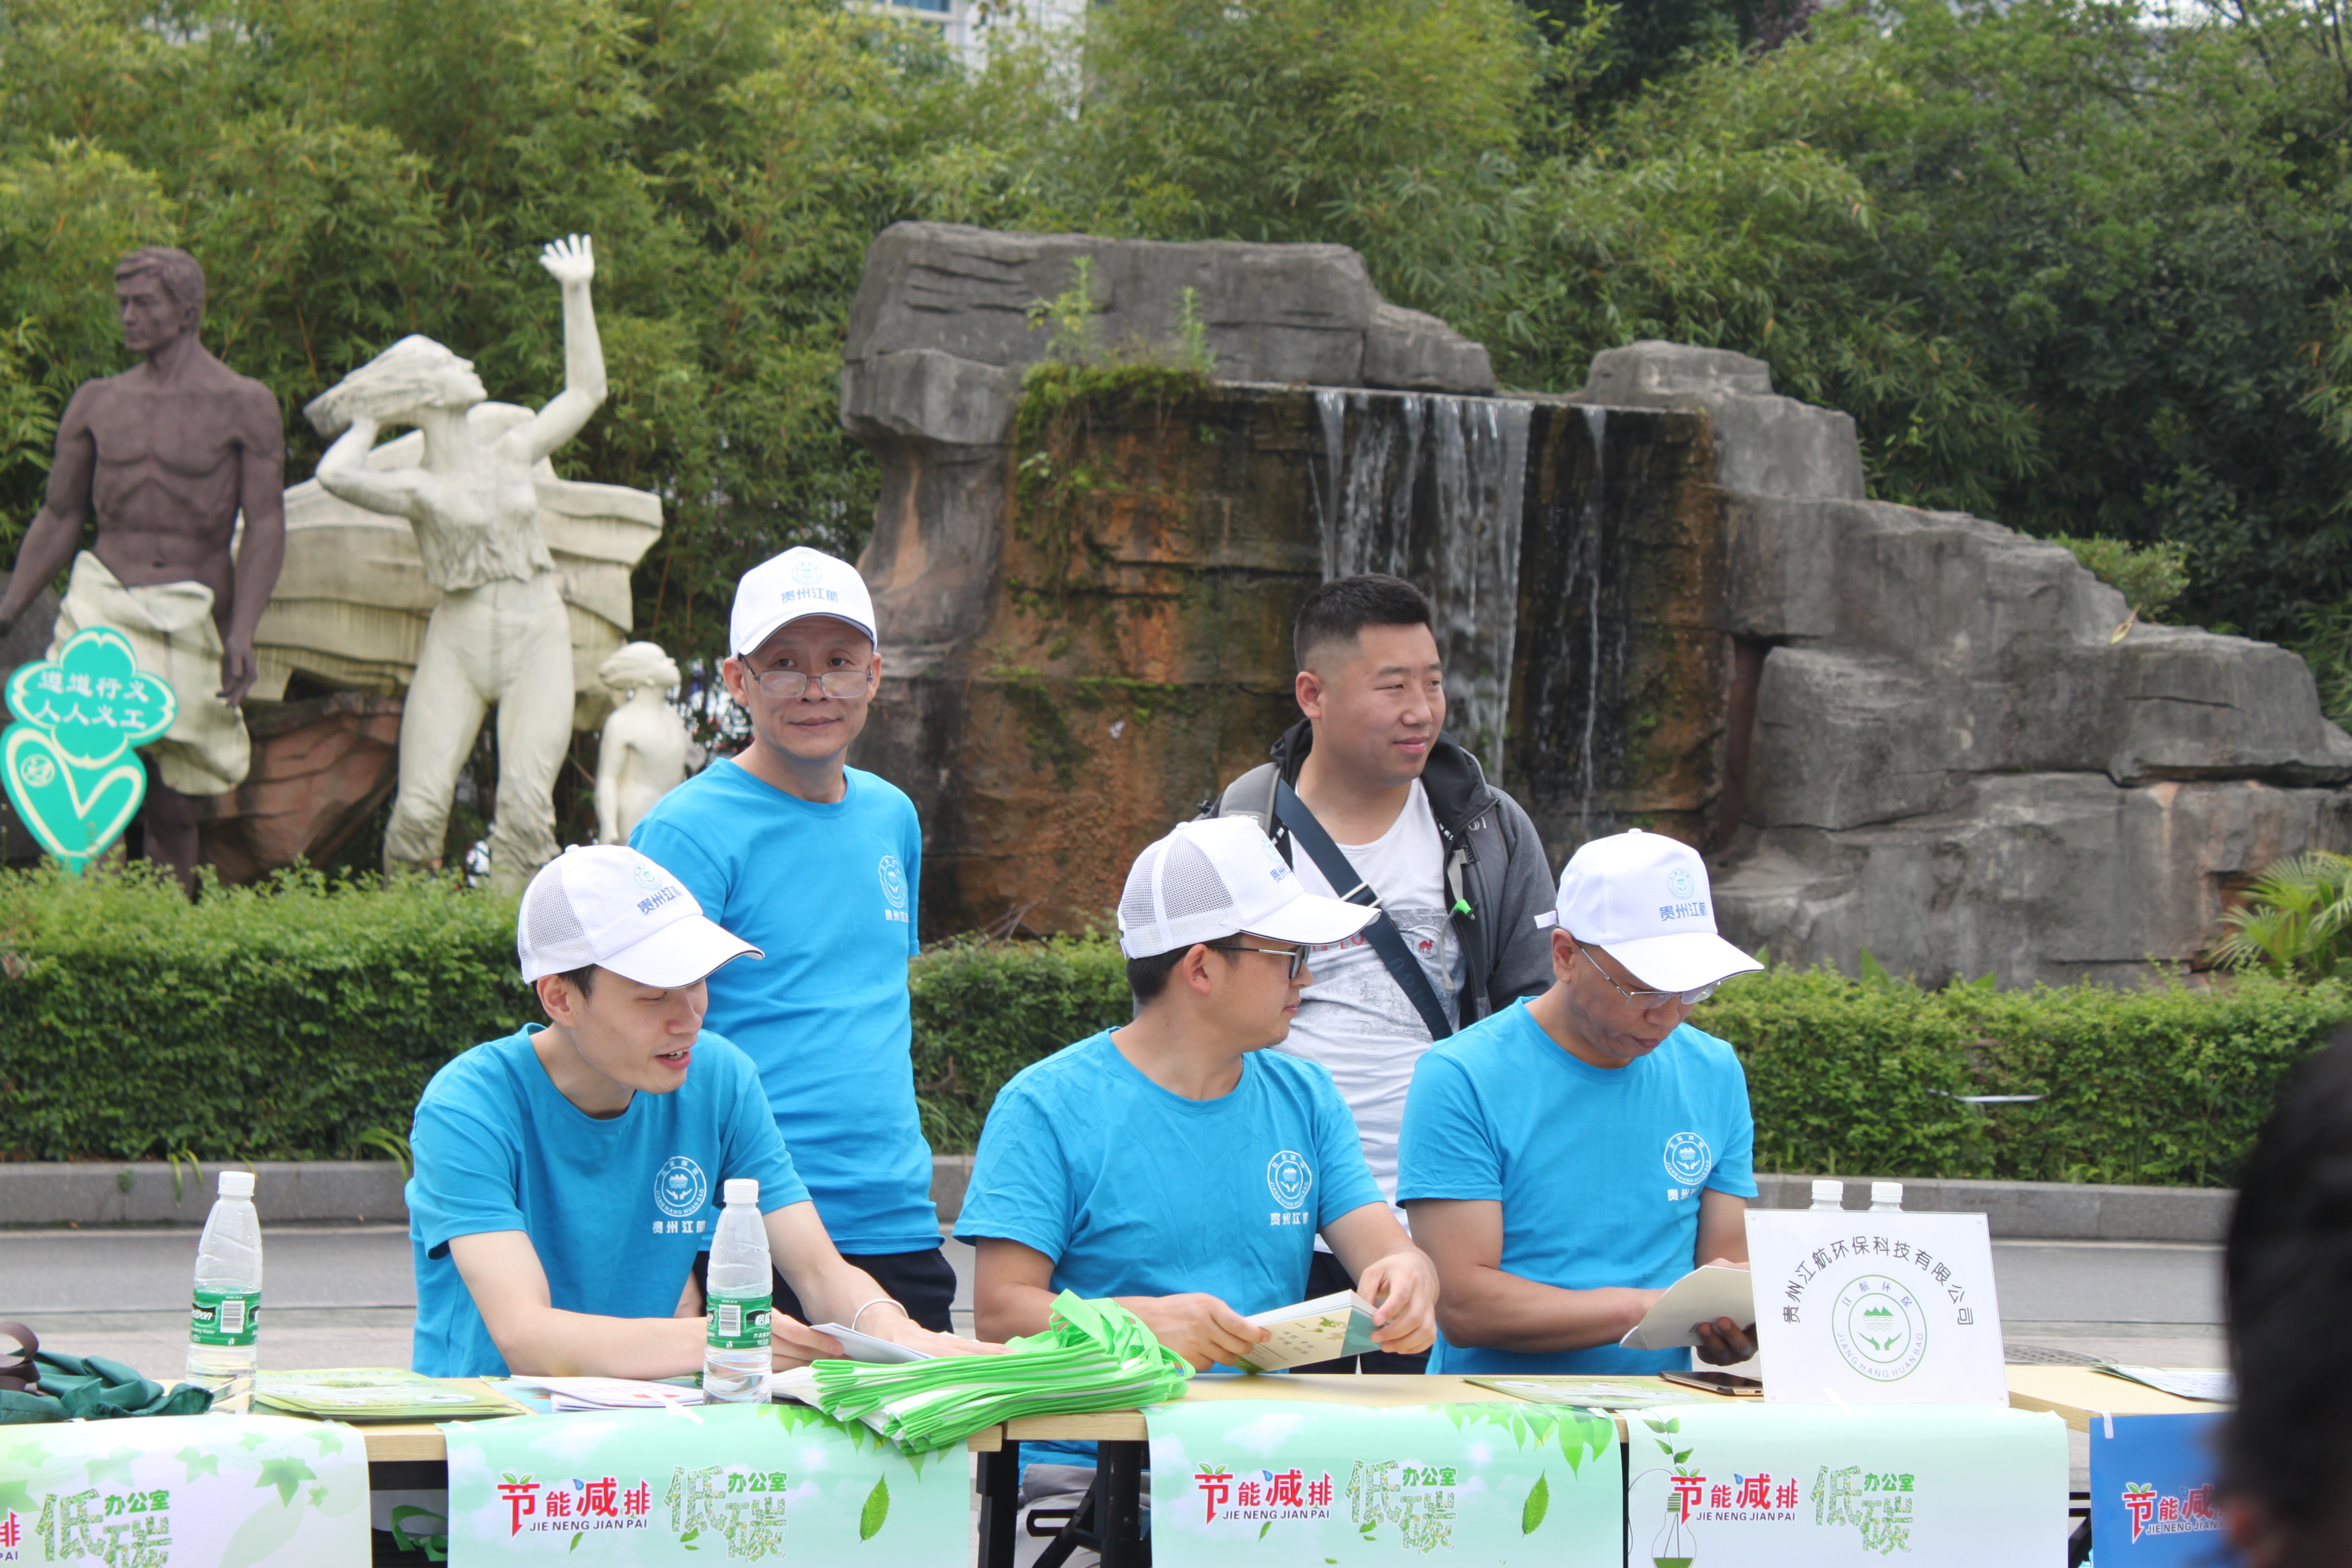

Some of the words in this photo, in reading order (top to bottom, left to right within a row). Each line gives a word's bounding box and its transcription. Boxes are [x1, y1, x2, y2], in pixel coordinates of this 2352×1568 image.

[34, 699, 147, 730] 人人义工
[684, 1201, 699, 1214] HUAN
[1782, 1235, 1974, 1325] 贵州江航环保科技有限公司
[1841, 1281, 1912, 1309] 江航环保
[1837, 1333, 1859, 1365] JIANG
[1860, 1363, 1889, 1378] HANG
[1891, 1355, 1916, 1376] HUAN
[1912, 1333, 1924, 1356] BAO
[728, 1471, 787, 1493] 办公室
[1403, 1467, 1456, 1487] 办公室
[1864, 1472, 1914, 1492] 办公室
[105, 1489, 169, 1517] 办公室
[497, 1472, 651, 1538] 节能减排
[1195, 1463, 1332, 1525] 节能减排
[1670, 1466, 1798, 1525] 节能减排
[530, 1522, 548, 1531] JIE
[553, 1521, 589, 1530] NENG
[593, 1519, 623, 1529] JIAN
[627, 1519, 647, 1528] PAI
[1223, 1511, 1240, 1519] JIE
[1244, 1510, 1277, 1519] NENG
[1280, 1510, 1307, 1519] JIAN
[1311, 1510, 1329, 1519] PAI
[1696, 1512, 1712, 1520] JIE
[1716, 1512, 1747, 1520] NENG
[1750, 1512, 1774, 1520] JIAN
[2123, 1483, 2222, 1541] 节能减
[2147, 1525, 2162, 1534] JIE
[2163, 1523, 2191, 1532] NENG
[2194, 1521, 2217, 1530] JIAN
